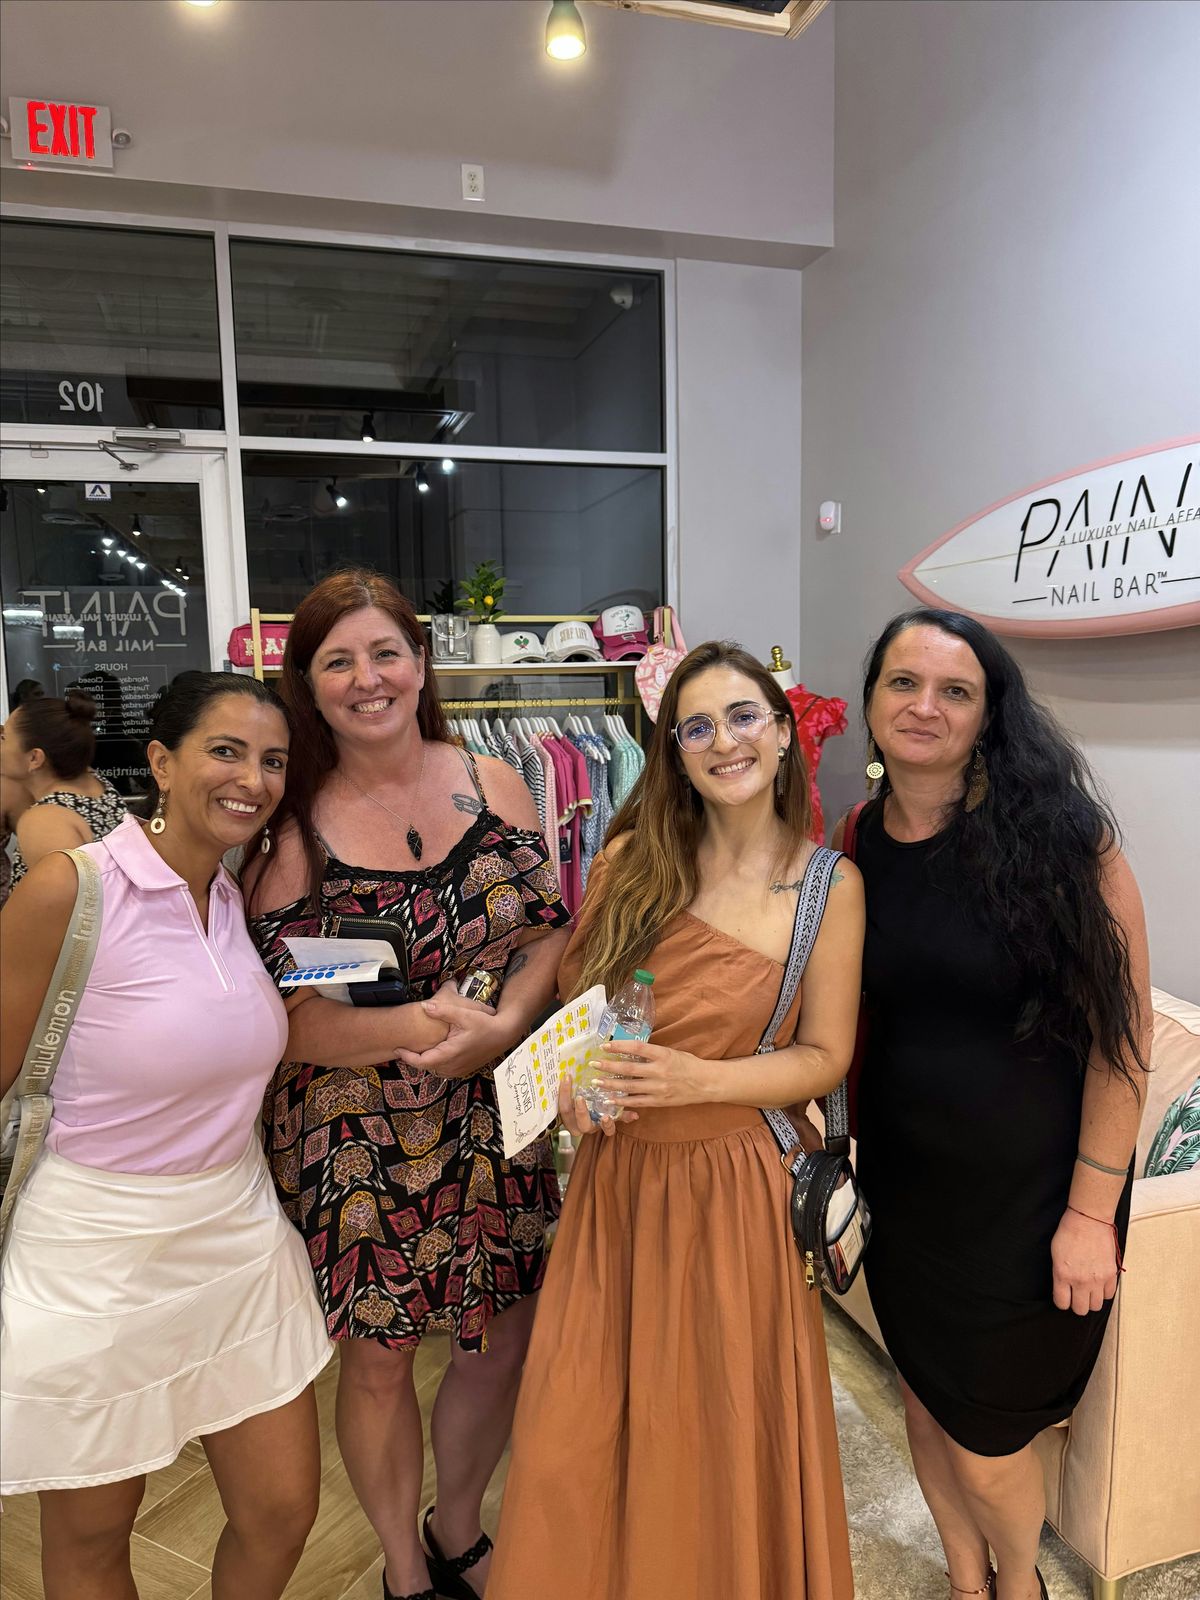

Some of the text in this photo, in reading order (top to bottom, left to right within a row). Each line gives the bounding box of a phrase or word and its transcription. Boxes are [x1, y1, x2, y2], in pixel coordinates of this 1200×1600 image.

[27, 100, 98, 160] EXIT
[1014, 462, 1200, 583] PAIN
[1059, 535, 1067, 546] A
[1071, 524, 1121, 545] LUXURY
[1127, 517, 1159, 533] NAIL
[1051, 581, 1100, 607] NAIL
[25, 988, 77, 1081] lululemon
[518, 1073, 532, 1113] BINGO
